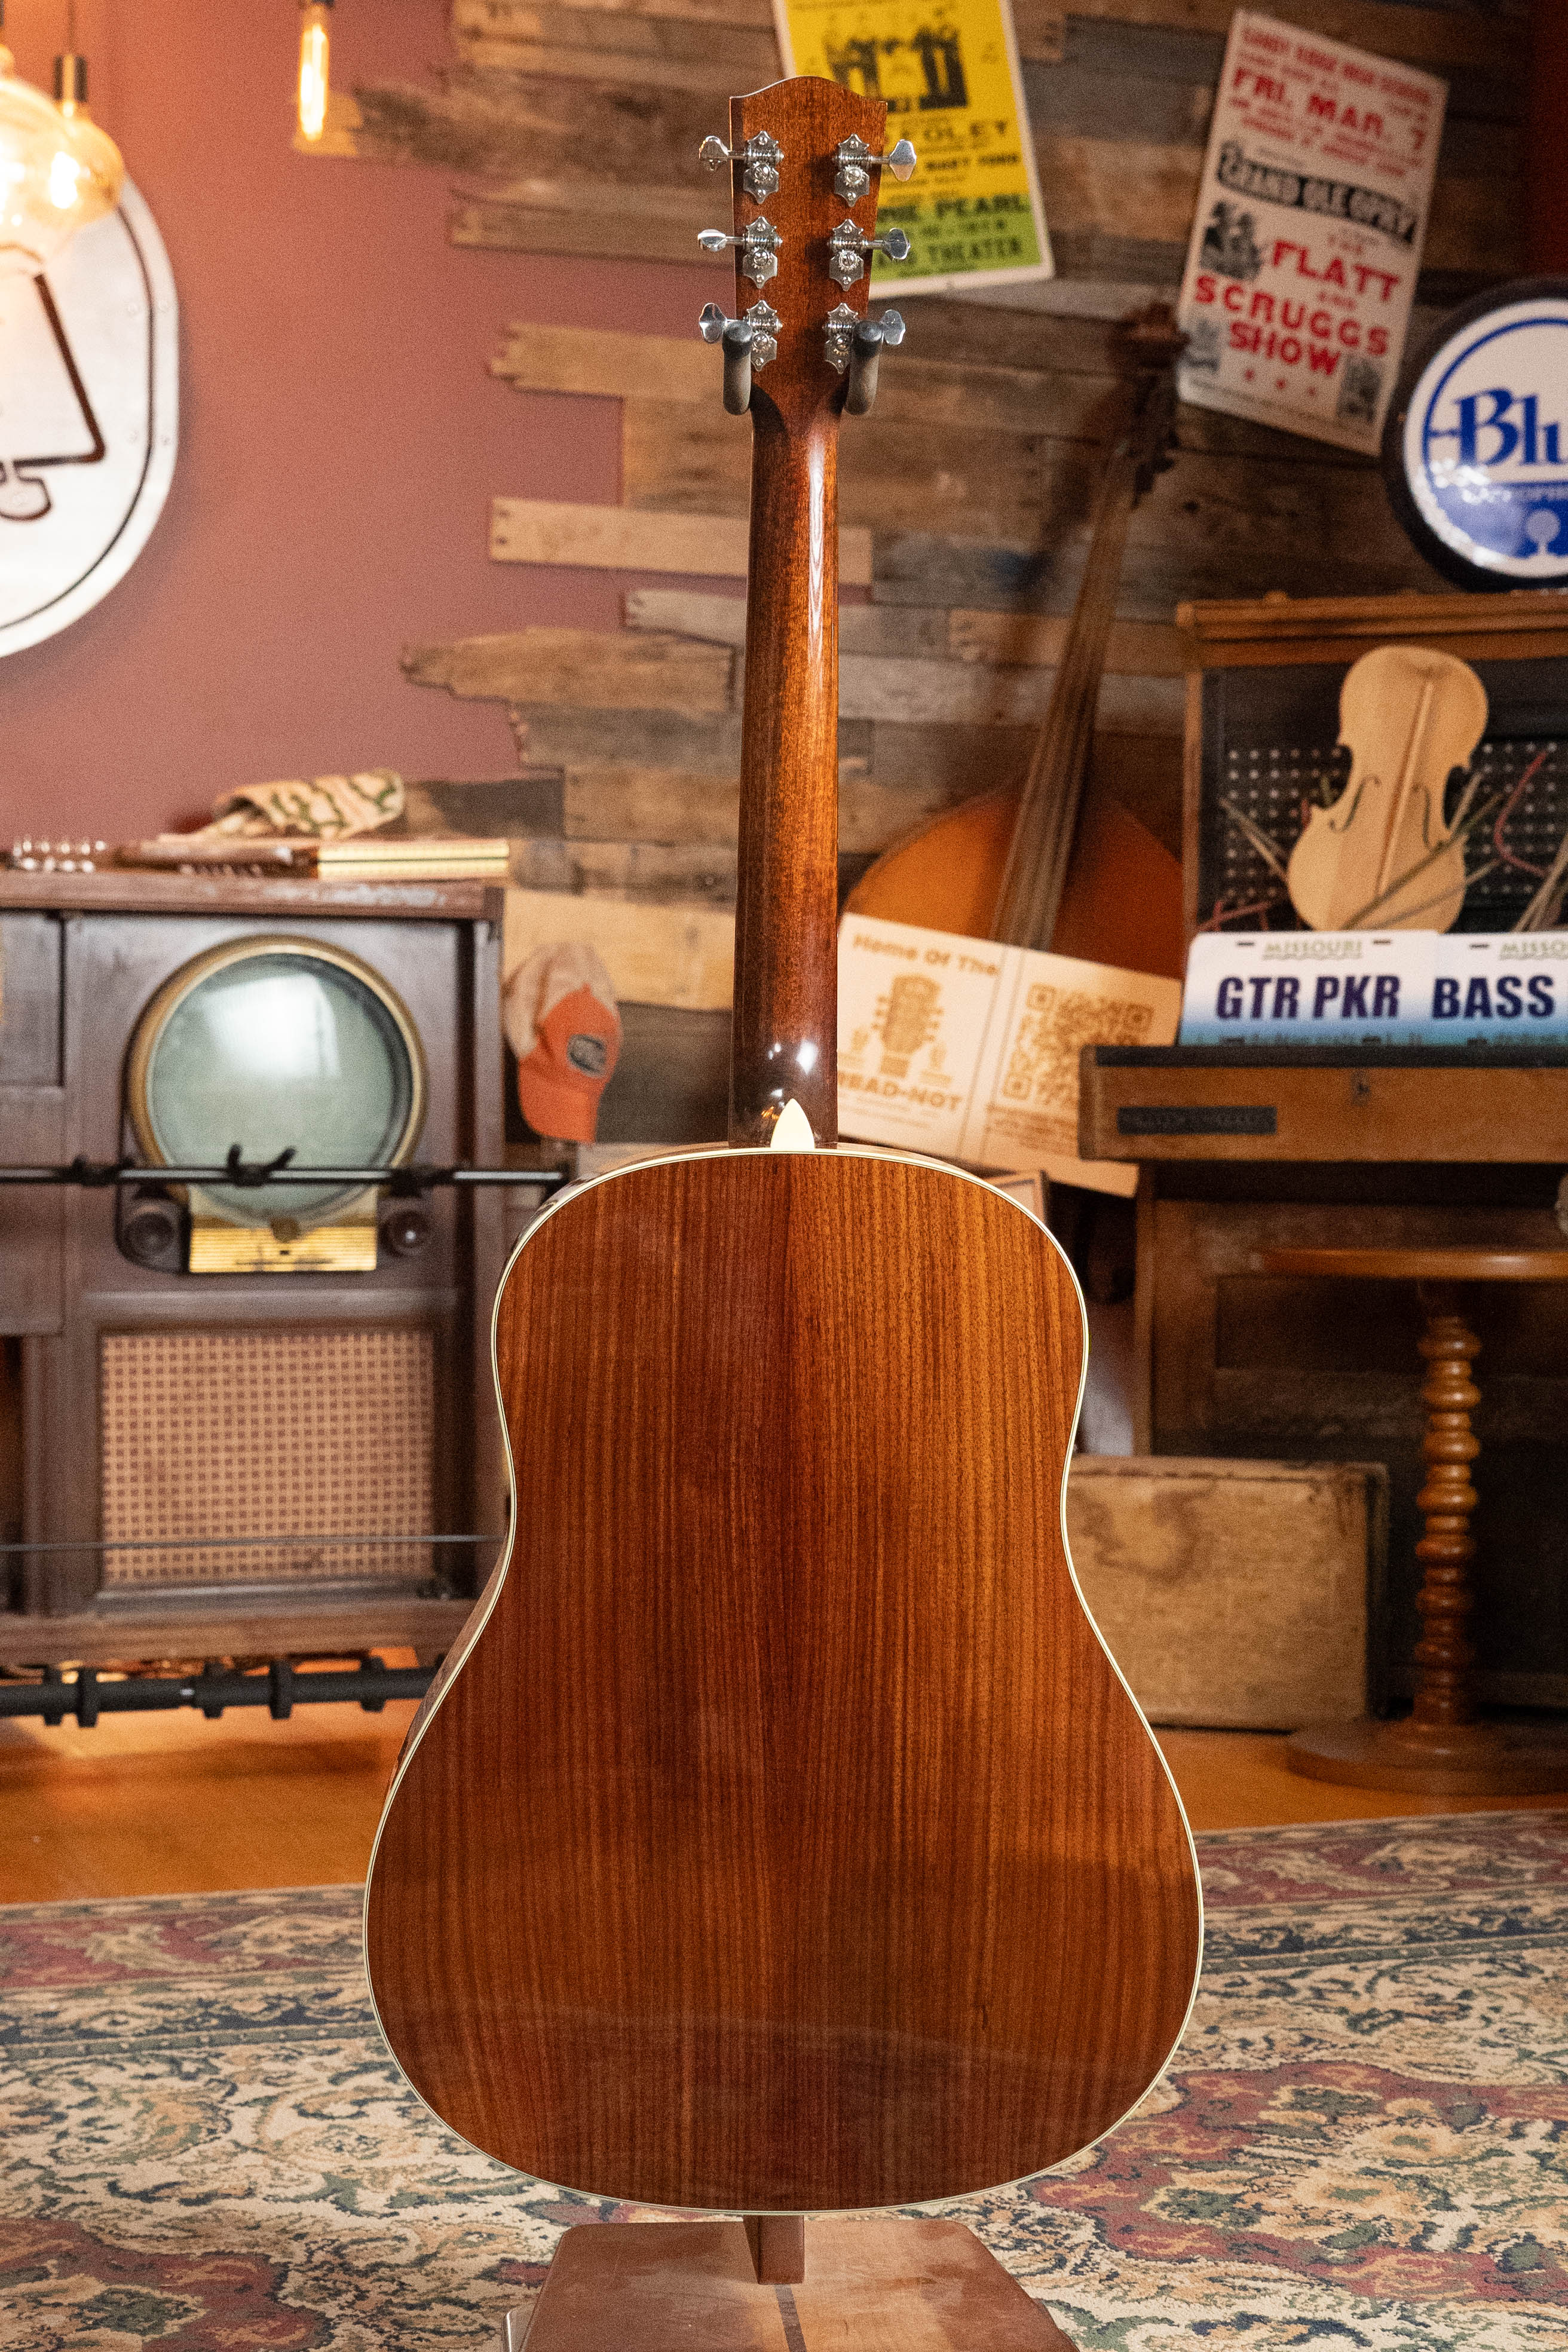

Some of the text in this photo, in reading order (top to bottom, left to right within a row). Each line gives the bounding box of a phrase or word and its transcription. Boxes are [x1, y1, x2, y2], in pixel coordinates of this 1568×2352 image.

[1272, 239, 1401, 302] FLATT
[1195, 274, 1390, 356] SCRUGGS
[1228, 320, 1342, 376] SHOW
[852, 933, 917, 961] Home
[958, 955, 1000, 976] The
[1263, 939, 1362, 958] MISSOURI
[1215, 975, 1402, 1019] GTR PKR
[1432, 975, 1555, 1019] BASS
